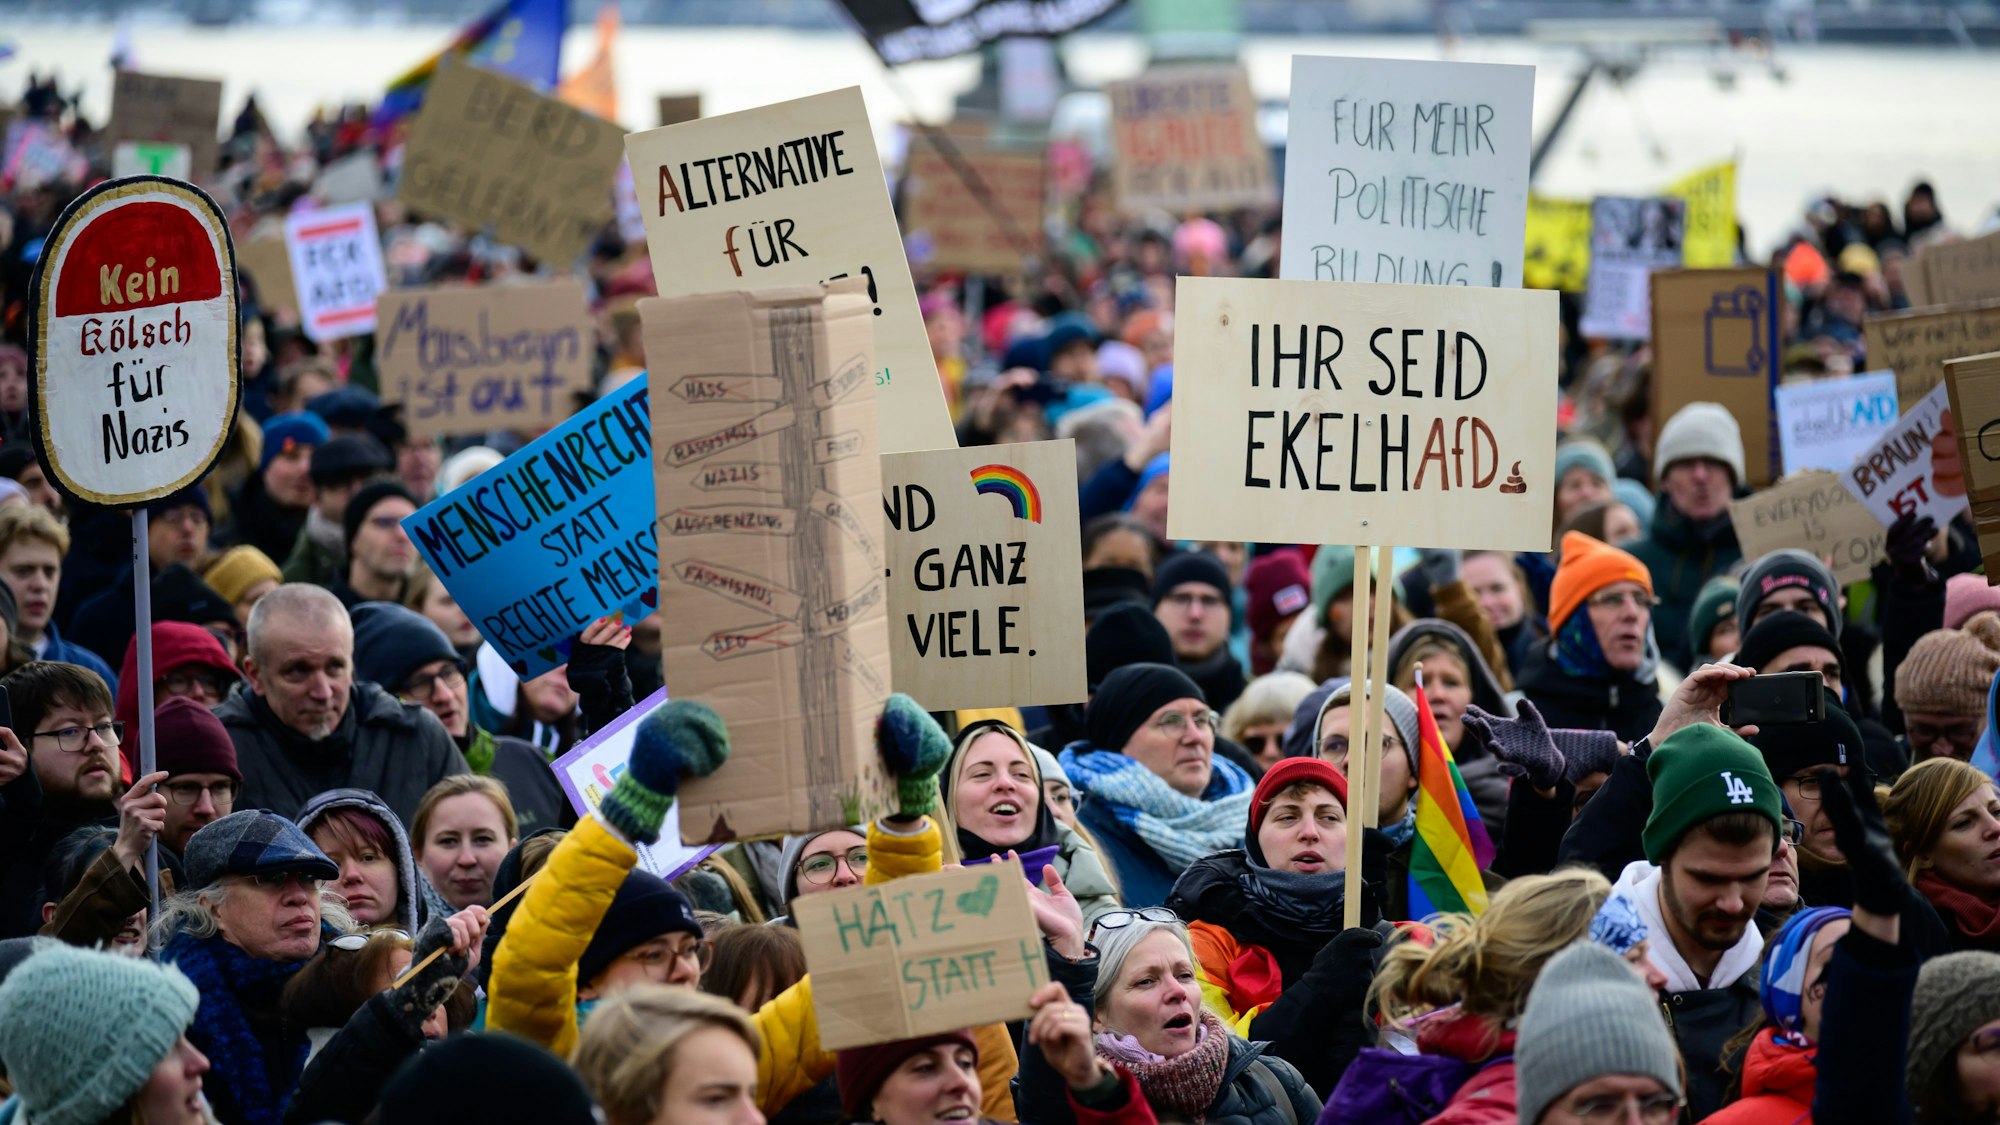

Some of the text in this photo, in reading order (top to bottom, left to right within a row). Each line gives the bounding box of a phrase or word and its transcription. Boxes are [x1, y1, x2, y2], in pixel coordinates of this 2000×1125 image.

[1412, 102, 1496, 157] MEHR
[658, 130, 854, 217] ALTERNATIVE
[1328, 167, 1496, 237] POLITISCHE
[100, 256, 180, 306] Kein
[80, 305, 191, 356] Kölsch
[106, 358, 172, 408] für
[1251, 323, 1488, 400] IHR SEID
[685, 382, 728, 399] HASS
[102, 408, 190, 464] Nazis
[1852, 420, 1934, 498] BRAUN
[704, 467, 761, 487] NAZIS
[540, 493, 620, 568] STATT
[913, 541, 1027, 592] GANZ
[482, 577, 592, 657] RECHTE
[906, 605, 1037, 659] VIELE.
[1720, 770, 1755, 805] LA
[900, 950, 997, 1011] STATT
